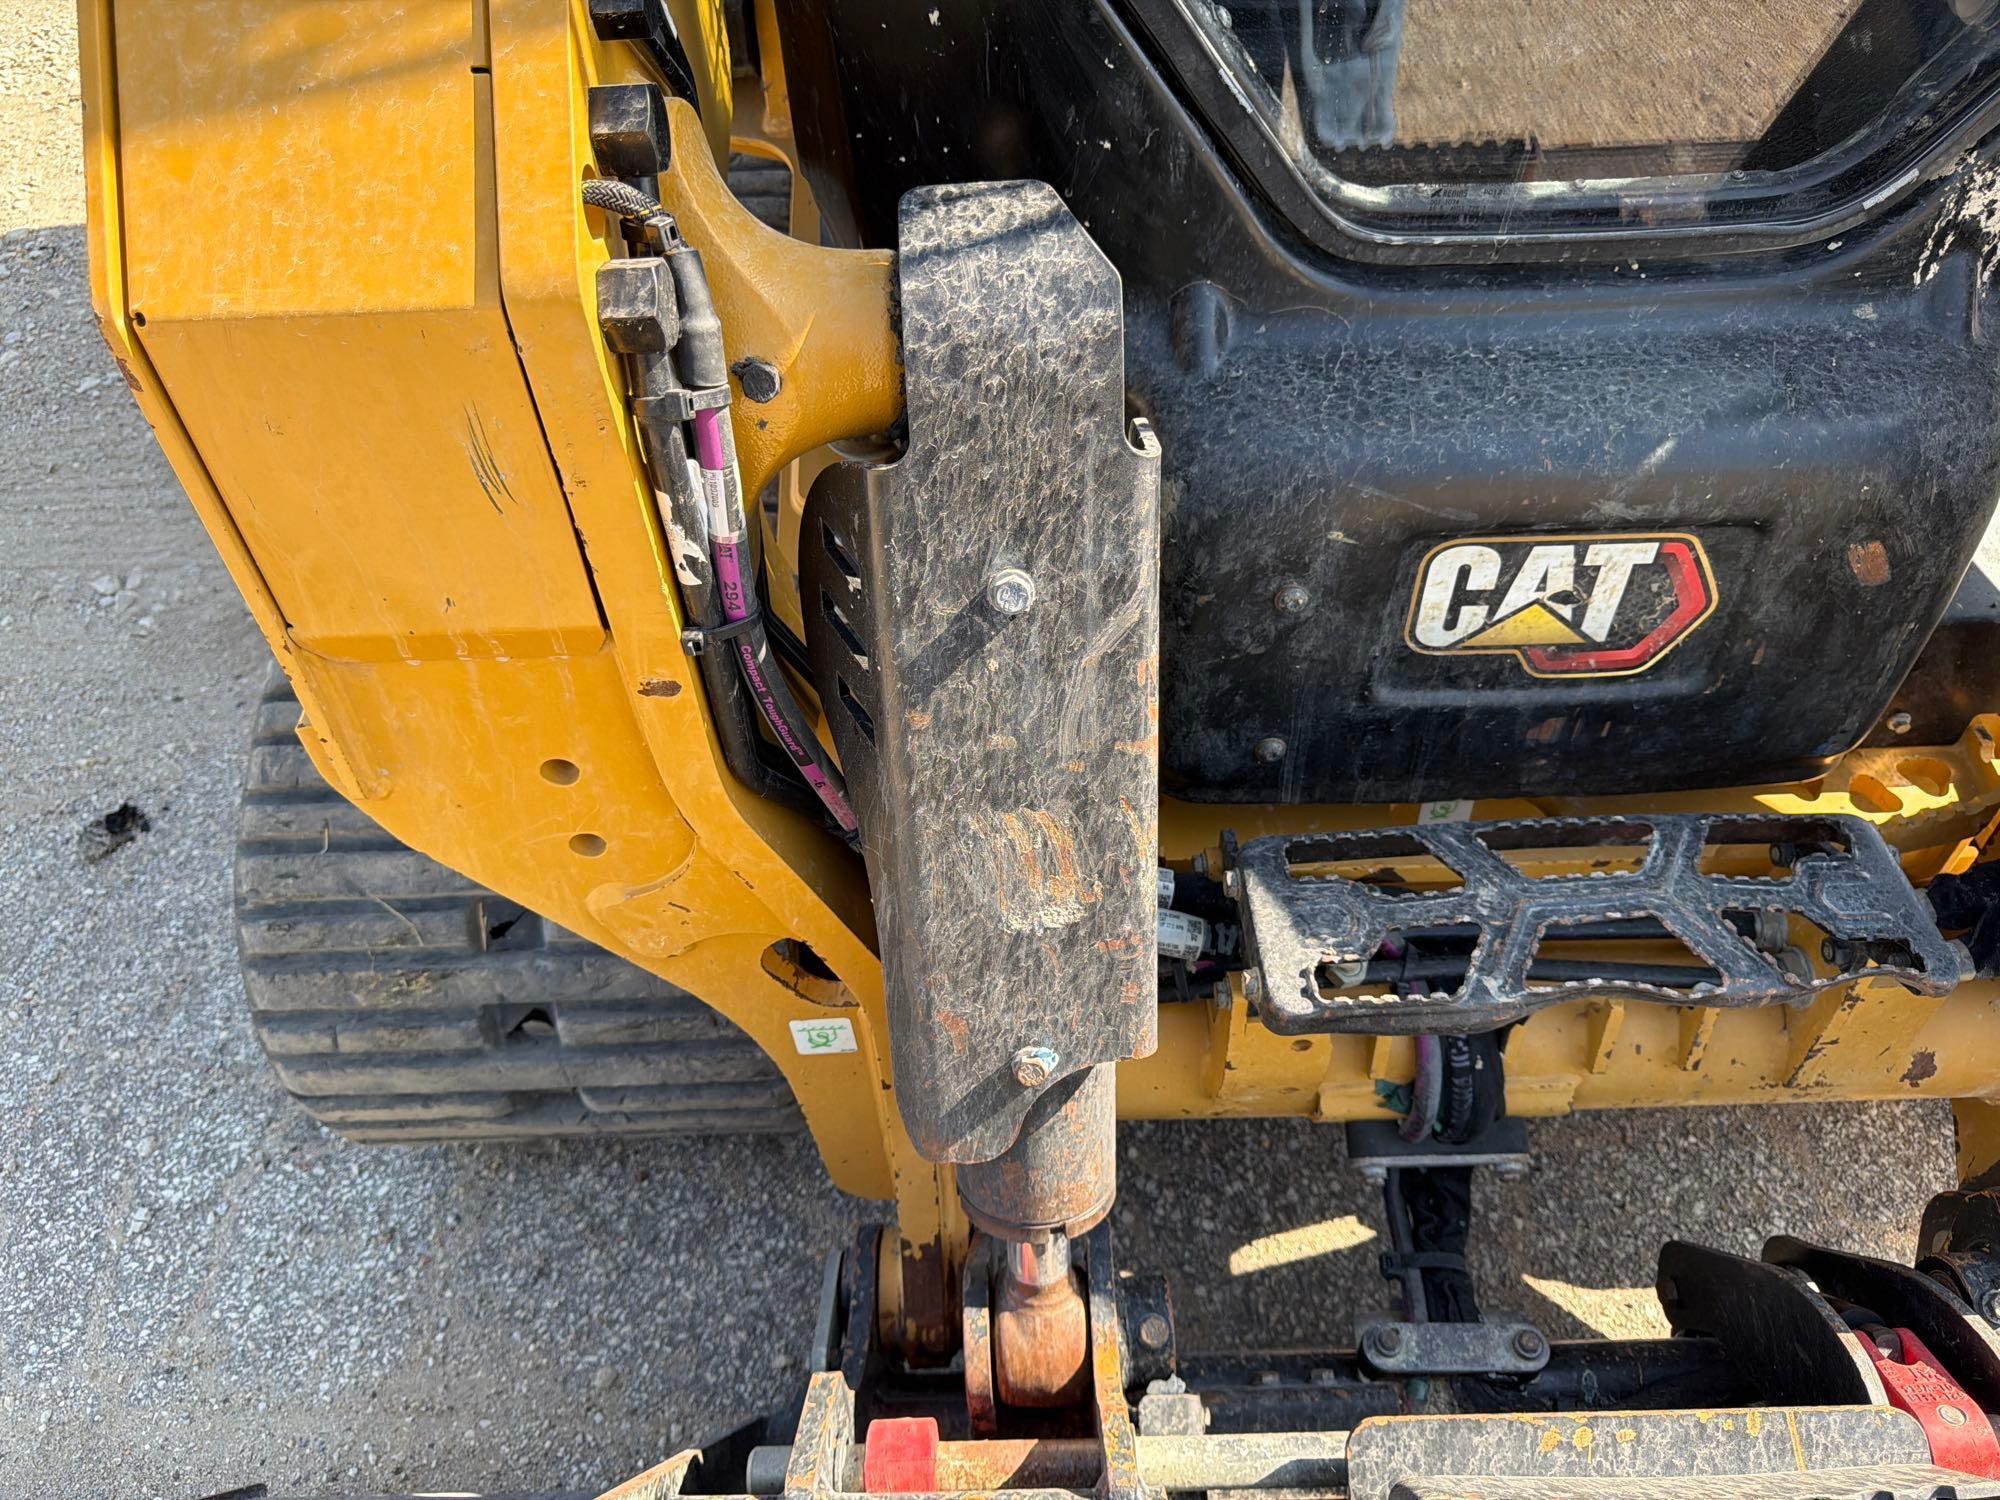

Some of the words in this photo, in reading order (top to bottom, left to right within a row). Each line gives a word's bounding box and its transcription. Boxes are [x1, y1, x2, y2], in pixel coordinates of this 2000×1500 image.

[723, 581, 741, 612] 294
[1415, 542, 1660, 648] CAT
[740, 645, 766, 693] Compact
